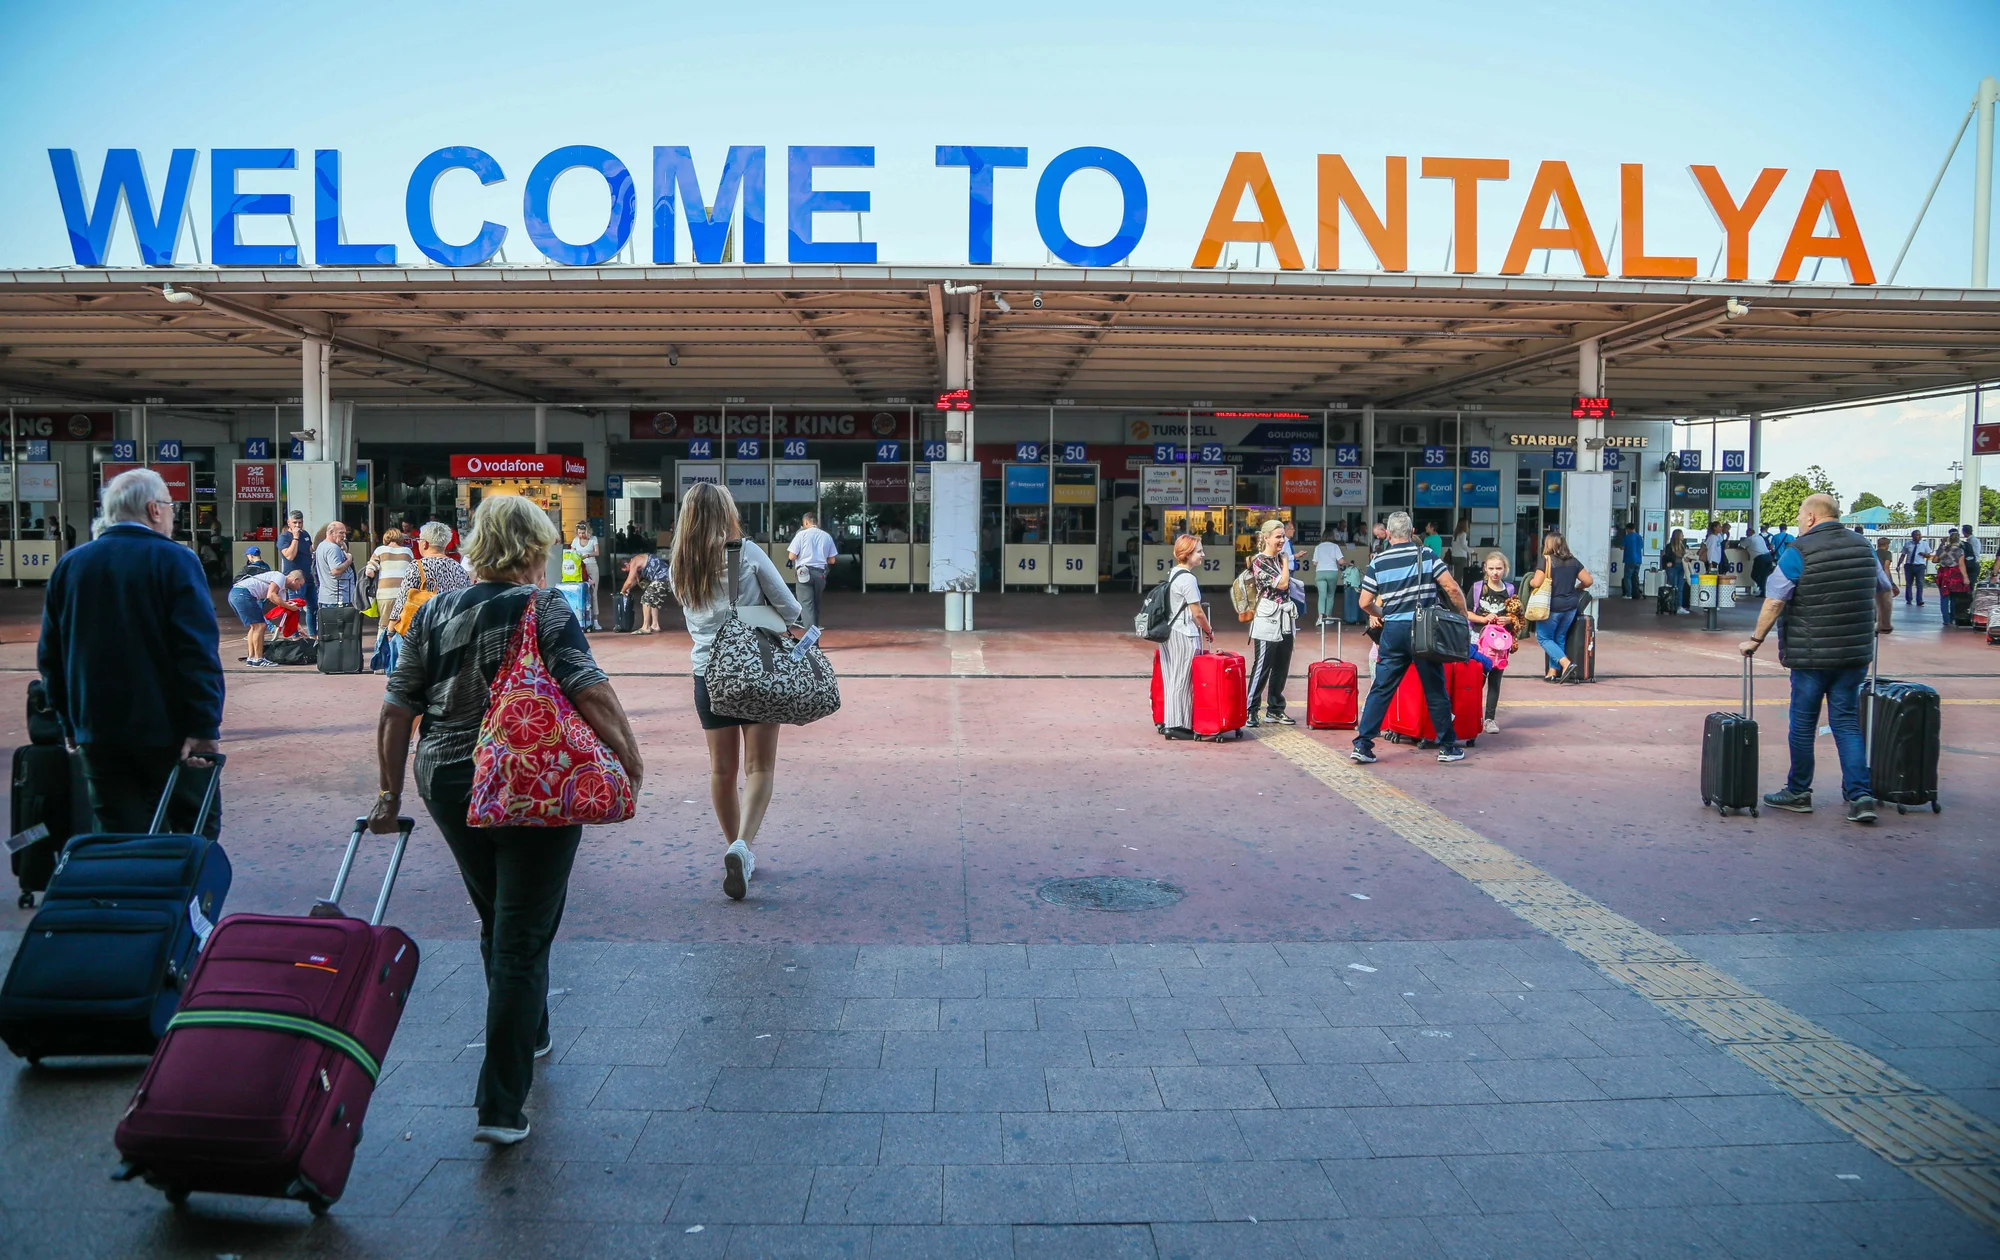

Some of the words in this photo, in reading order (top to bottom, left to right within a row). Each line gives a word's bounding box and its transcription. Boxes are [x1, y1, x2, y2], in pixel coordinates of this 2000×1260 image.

[48, 144, 877, 268] WELCOME
[935, 145, 1148, 268] TO
[1191, 150, 1877, 285] ANTALYA
[1579, 398, 1609, 409] TAXI
[693, 415, 788, 434] BURGER
[795, 415, 855, 434] KING
[1152, 425, 1217, 436] TURKCELL
[1268, 431, 1320, 439] GOLDPHONE
[1510, 434, 1577, 446] STARBUC
[1605, 436, 1649, 448] OFFEE
[28, 446, 47, 456] 38F
[114, 444, 133, 458] 39
[160, 444, 179, 458] 40
[248, 441, 266, 456] 41
[292, 442, 304, 456] 4
[690, 442, 710, 456] 44
[738, 442, 758, 456] 45
[785, 442, 806, 456] 46
[878, 445, 898, 459] 47
[925, 445, 946, 458] 48
[1018, 446, 1038, 460] 49
[1065, 446, 1085, 460] 50
[1157, 447, 1175, 461] 51
[1202, 447, 1222, 461] 52
[1292, 448, 1311, 462] 53
[1338, 449, 1357, 463] 54
[1425, 450, 1444, 464] 55
[1470, 451, 1489, 464] 56
[1556, 452, 1574, 466] 57
[1682, 454, 1700, 467] 59
[1725, 454, 1743, 467] 60
[247, 467, 264, 476] 242
[483, 459, 544, 472] vodafone
[569, 461, 585, 474] vodafone
[247, 476, 264, 485] TOUR
[697, 477, 718, 485] PEGAS
[868, 478, 886, 486] Pegas
[886, 477, 907, 486] Select
[1285, 479, 1317, 487] easyJet
[1719, 483, 1749, 491] ODEON
[1285, 486, 1317, 494] holidays
[1343, 488, 1362, 496] Coral
[1687, 486, 1709, 495] Coral
[22, 554, 50, 566] 38F
[879, 558, 896, 570] 47
[1018, 558, 1036, 571] 49
[1065, 558, 1083, 571] 50
[1203, 559, 1220, 571] 52
[1728, 562, 1743, 574] 60
